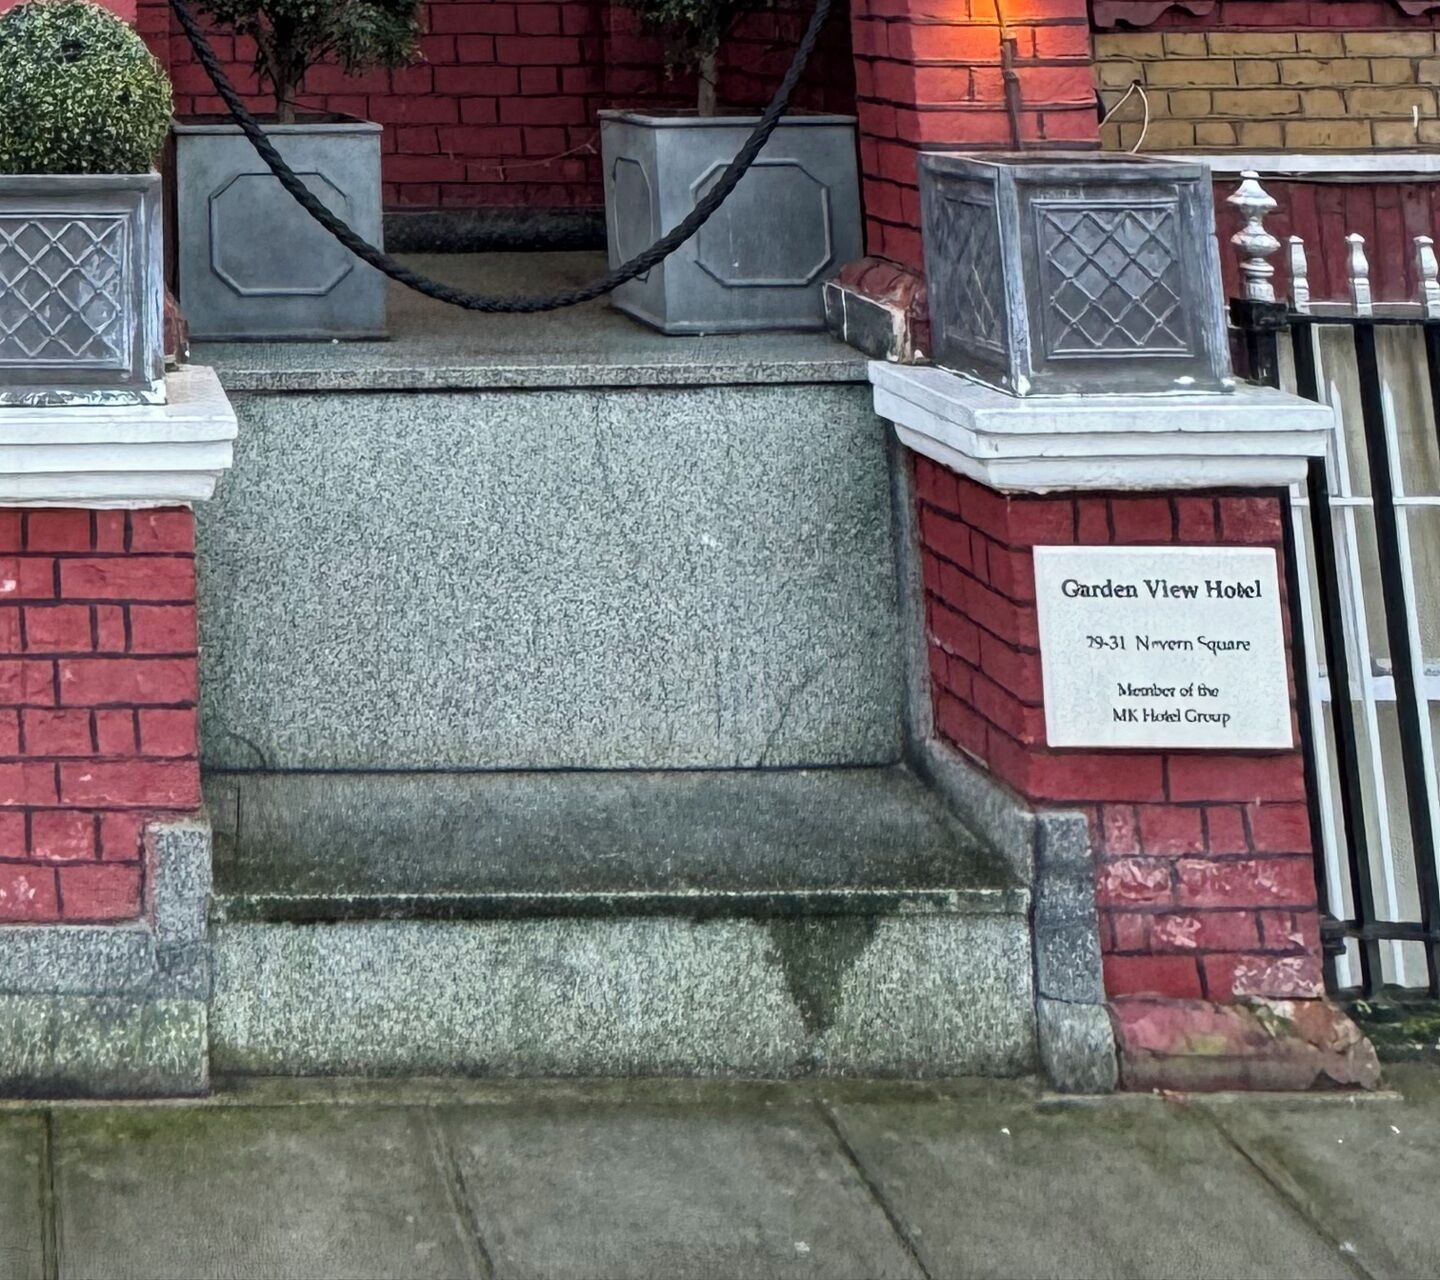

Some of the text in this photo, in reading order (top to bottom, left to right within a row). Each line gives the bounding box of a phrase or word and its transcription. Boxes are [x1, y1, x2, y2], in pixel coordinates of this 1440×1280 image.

[1061, 579, 1262, 598] Garden View Hotel
[1136, 635, 1193, 651] Nevern
[1197, 635, 1251, 656] Square
[1117, 682, 1219, 698] Member of the
[1113, 708, 1231, 728] MK Hotel Group
